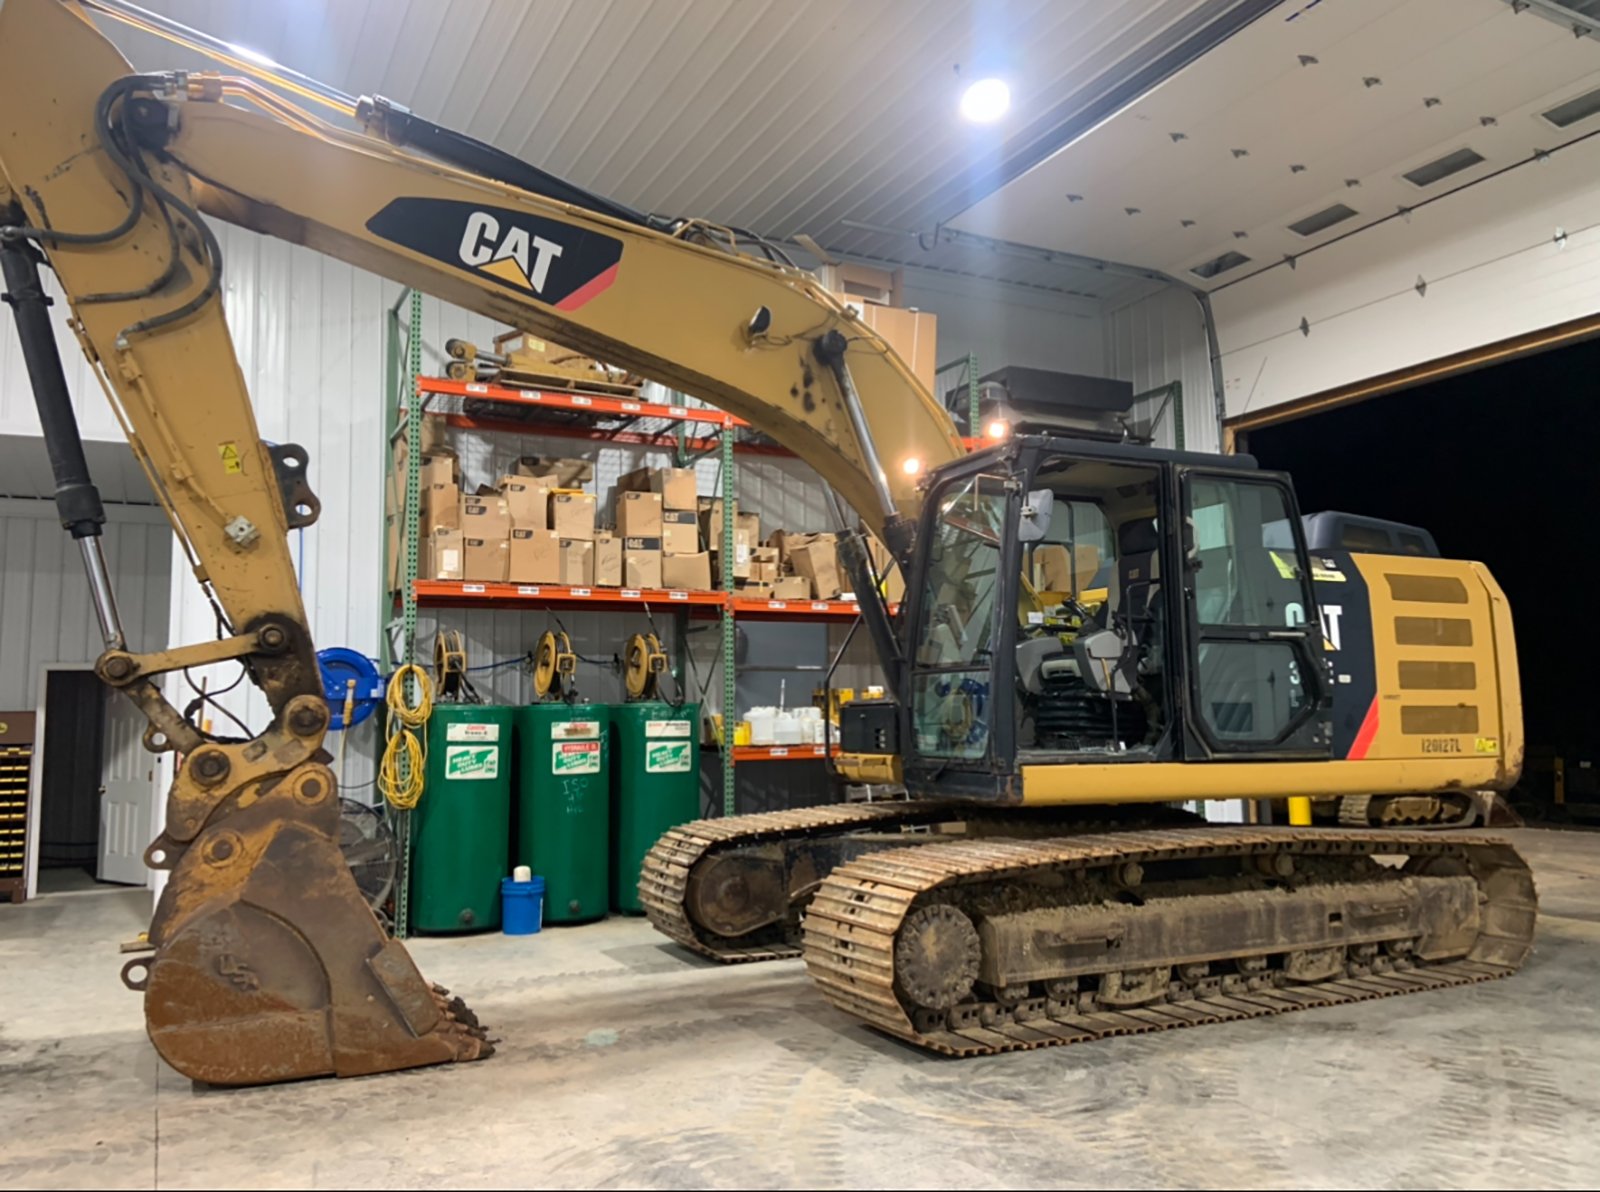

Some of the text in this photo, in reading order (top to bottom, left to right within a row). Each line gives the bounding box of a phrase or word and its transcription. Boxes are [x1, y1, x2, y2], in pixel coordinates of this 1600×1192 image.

[459, 211, 563, 294] CAT
[665, 513, 679, 522] CAT
[514, 530, 527, 539] CAT
[628, 539, 644, 549] CAT
[1285, 602, 1343, 651] CT
